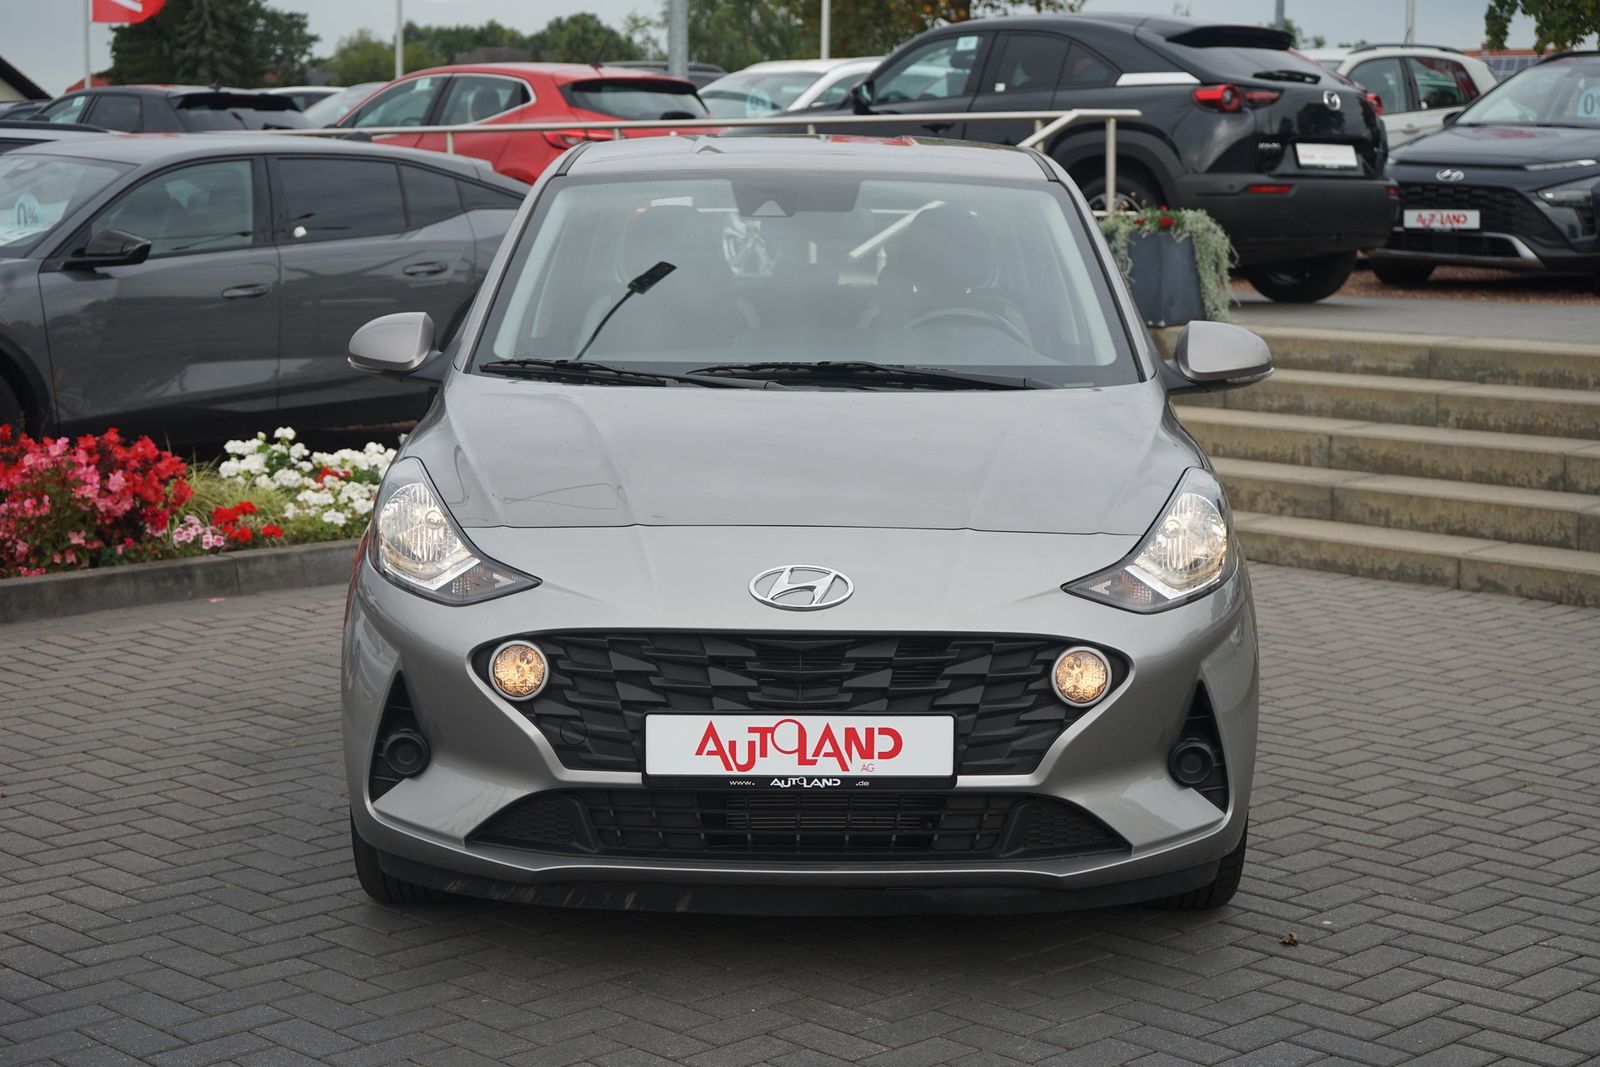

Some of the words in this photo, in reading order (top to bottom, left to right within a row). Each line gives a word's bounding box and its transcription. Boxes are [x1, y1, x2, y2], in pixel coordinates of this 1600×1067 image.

[695, 718, 904, 772] AUTOLAND
[860, 763, 875, 773] AG
[770, 776, 841, 788] AUTOLAND
